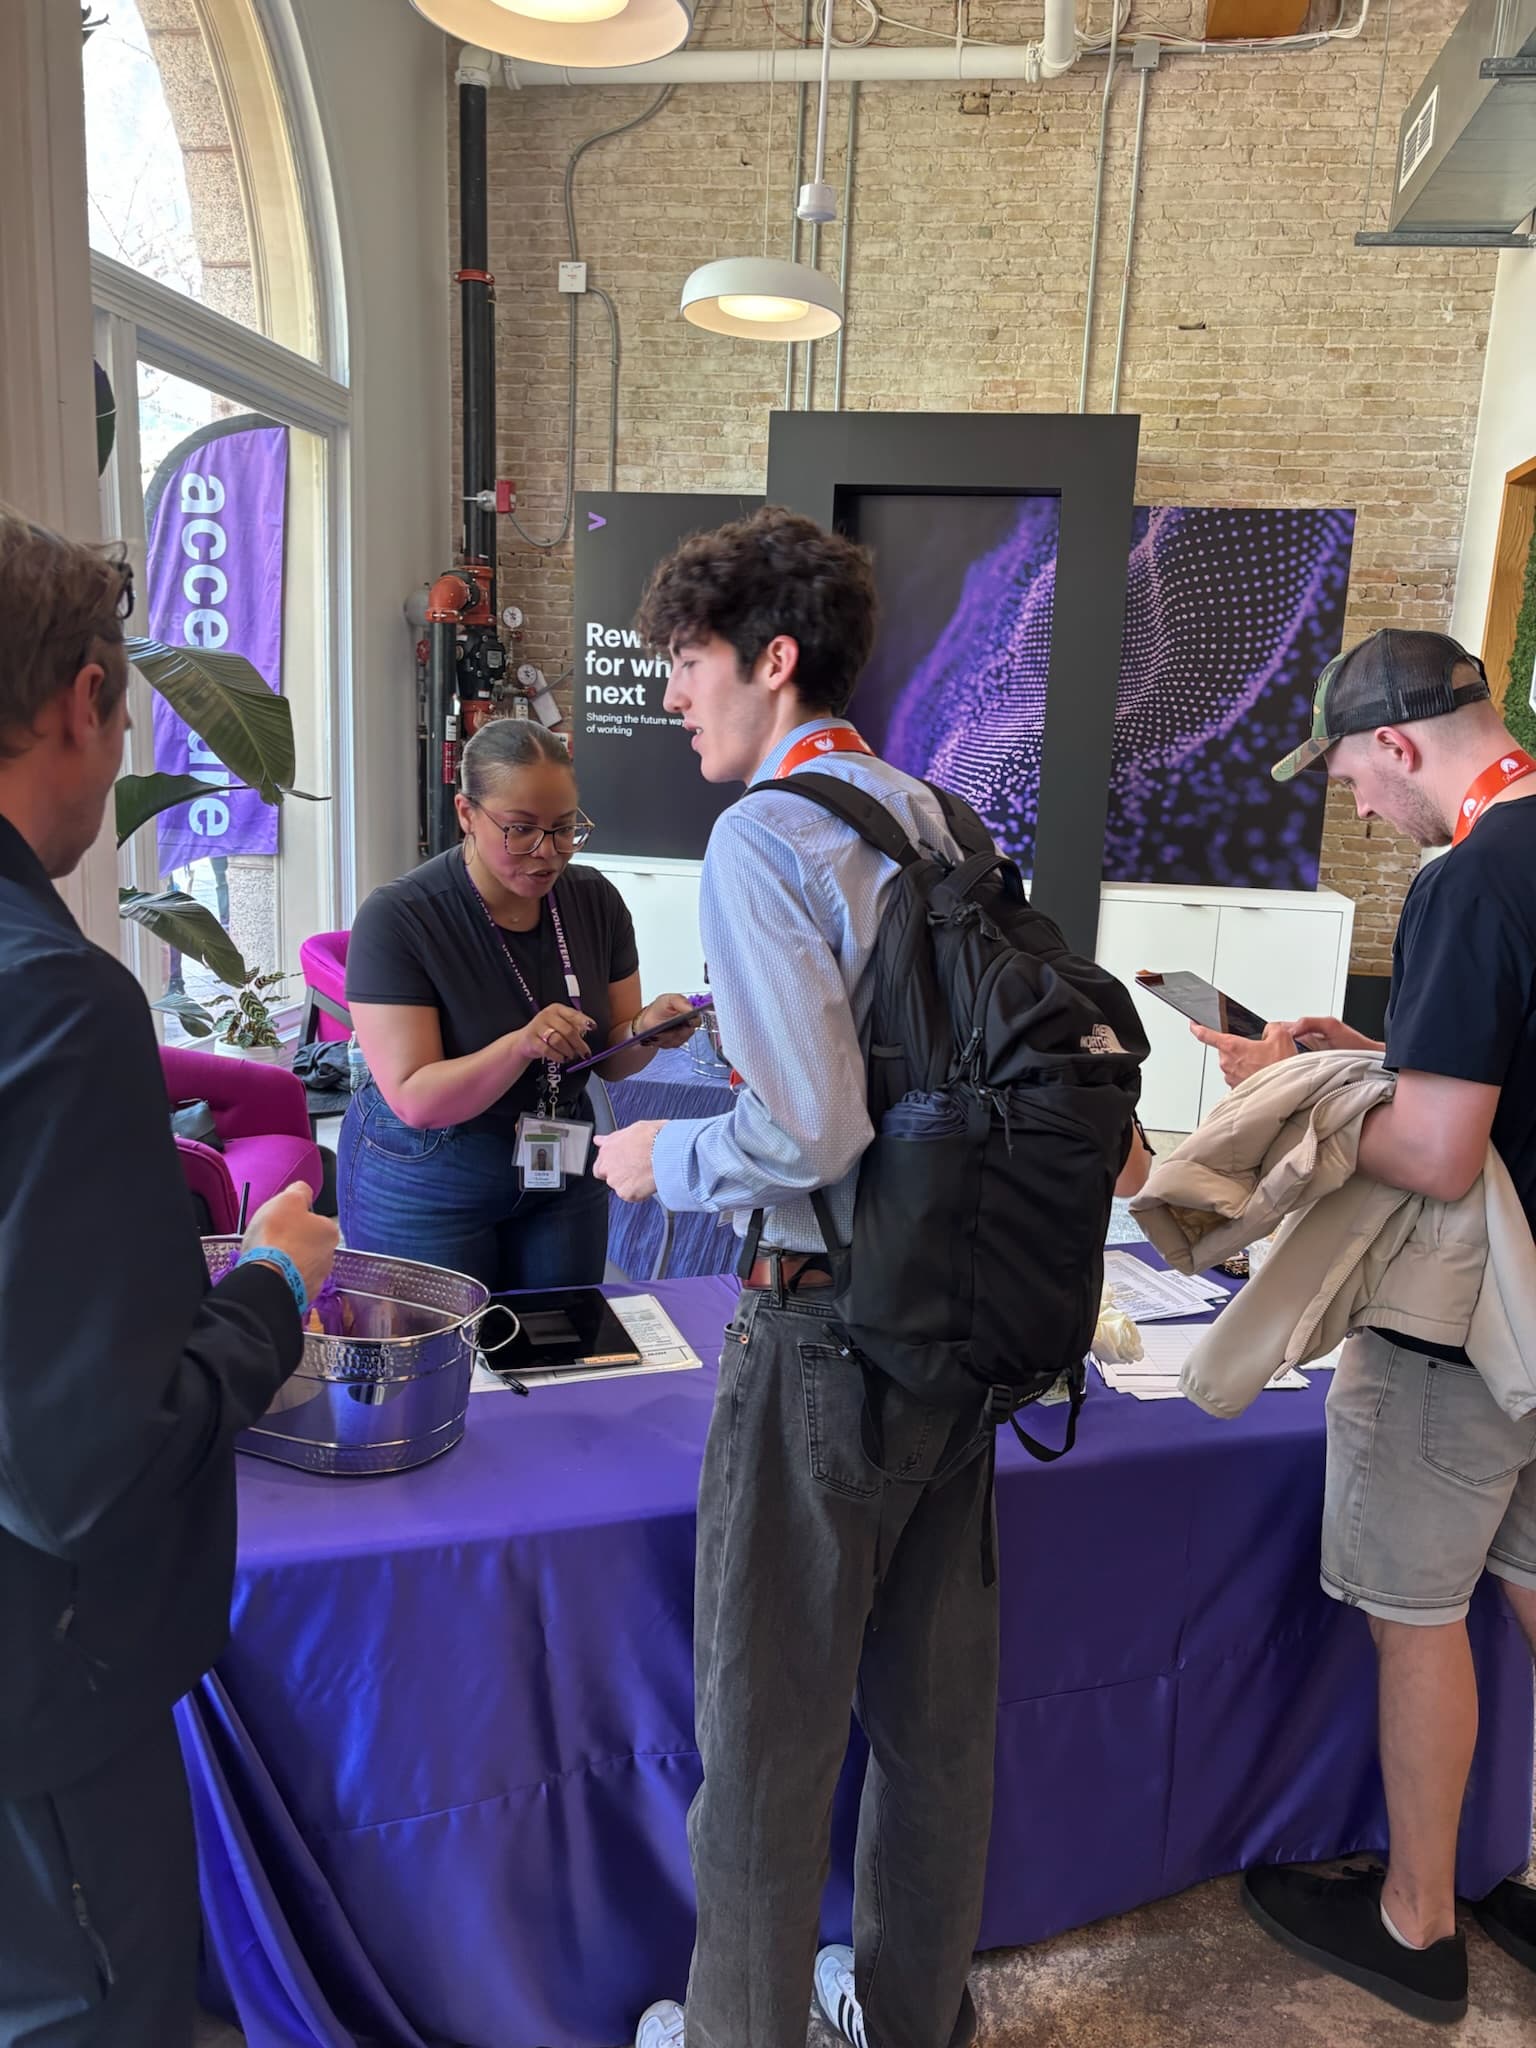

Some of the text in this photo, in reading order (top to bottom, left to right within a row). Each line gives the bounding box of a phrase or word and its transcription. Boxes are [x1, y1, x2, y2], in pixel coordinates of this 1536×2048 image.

[586, 622, 641, 648] Rew
[181, 472, 230, 836] acceure
[585, 650, 672, 678] for wh
[585, 684, 646, 706] next
[586, 712, 622, 724] Shaping
[624, 714, 639, 724] the
[640, 714, 667, 725] future
[586, 724, 632, 737] of working
[551, 907, 571, 969] VOLUNTEER
